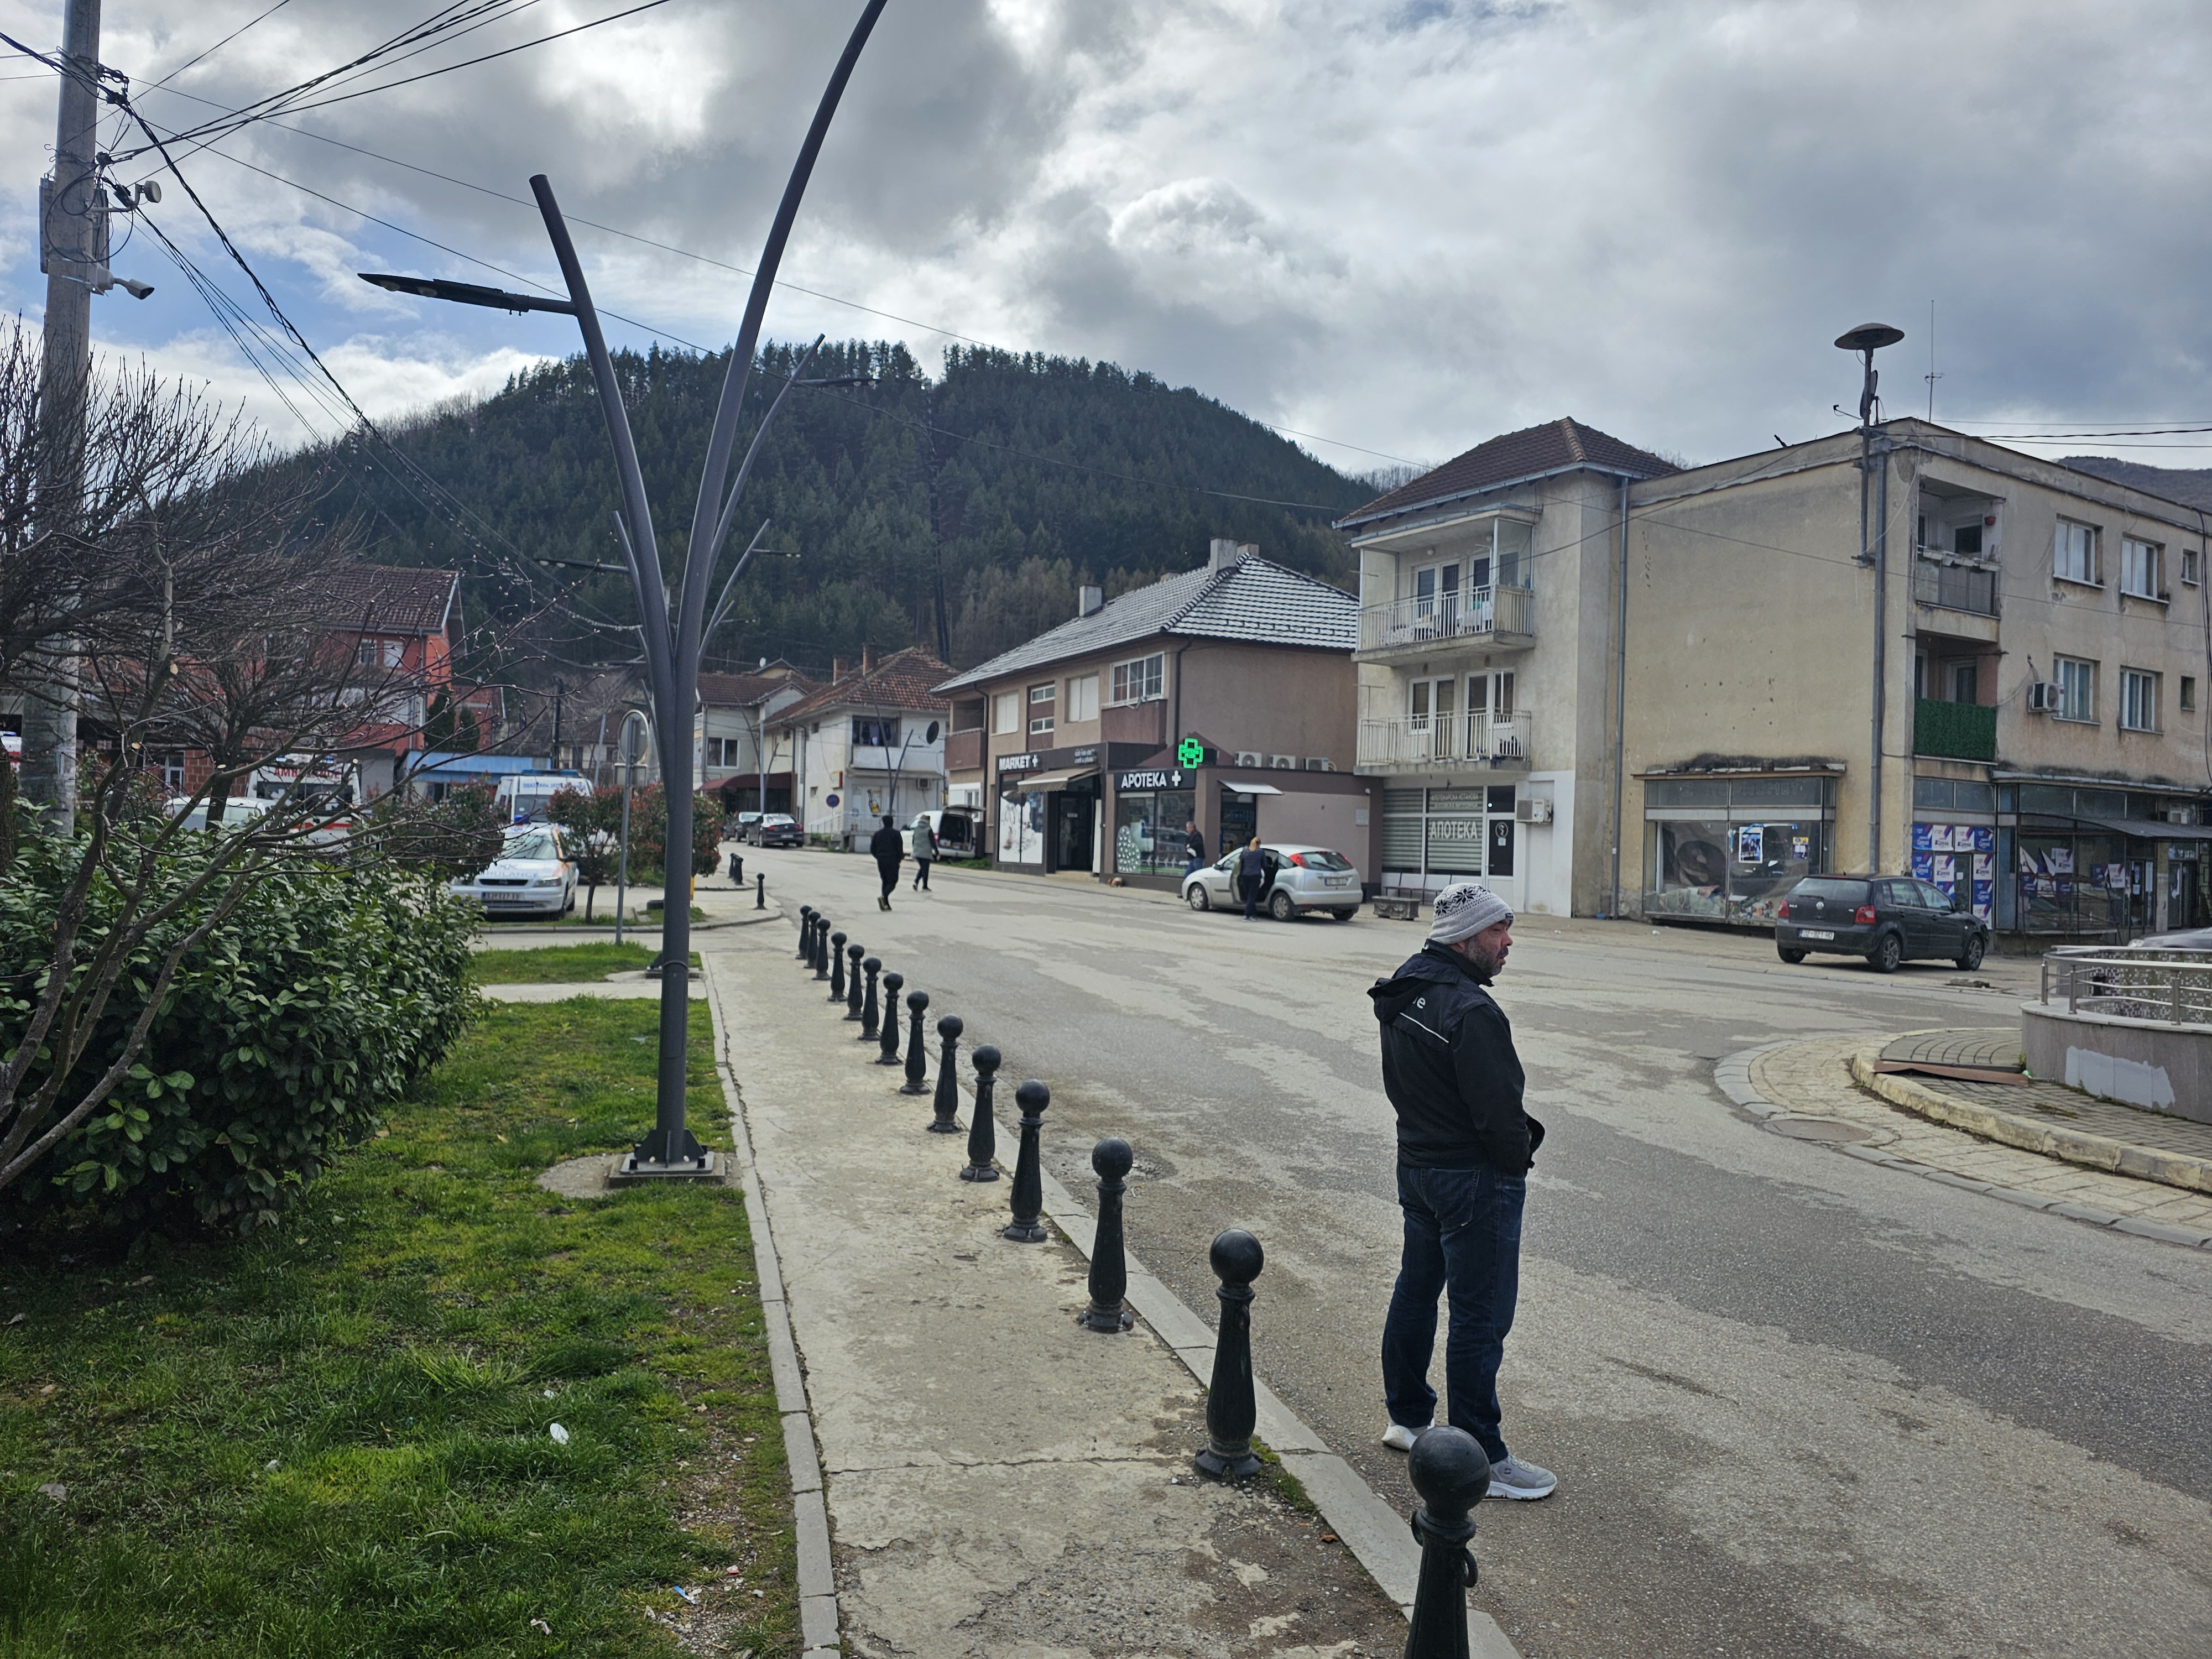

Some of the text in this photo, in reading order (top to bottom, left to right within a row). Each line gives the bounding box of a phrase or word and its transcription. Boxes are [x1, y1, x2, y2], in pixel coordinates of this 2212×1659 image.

[999, 755, 1030, 771] MARKET
[1121, 772, 1167, 788] APOTEKA
[1430, 821, 1478, 839] АПОТЕКА
